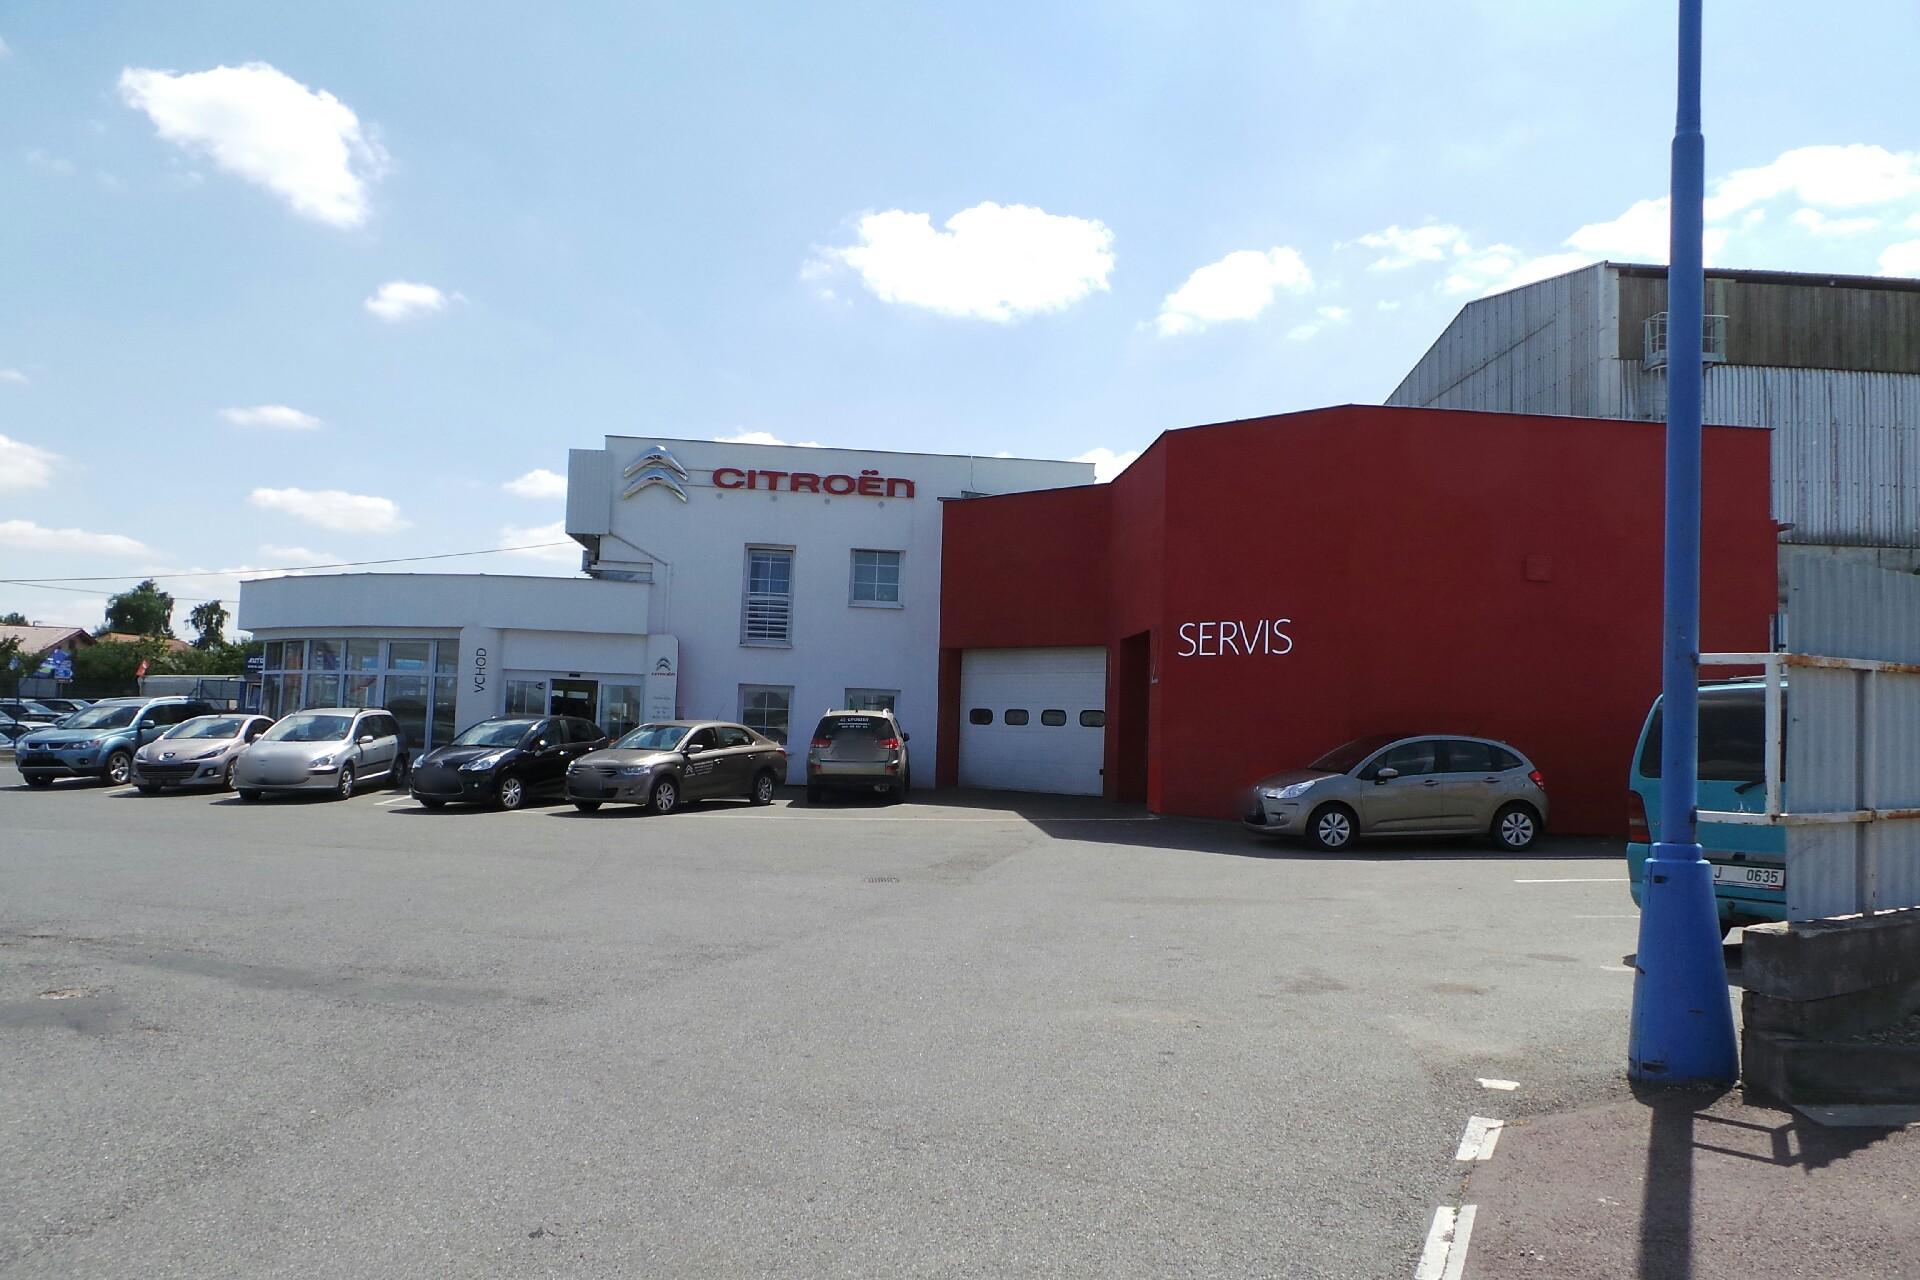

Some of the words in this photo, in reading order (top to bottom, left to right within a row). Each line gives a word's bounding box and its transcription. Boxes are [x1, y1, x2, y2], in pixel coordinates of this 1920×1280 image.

[1177, 618, 1293, 657] SERVIS
[473, 647, 487, 693] VCHOD
[1746, 869, 1779, 883] 0635
